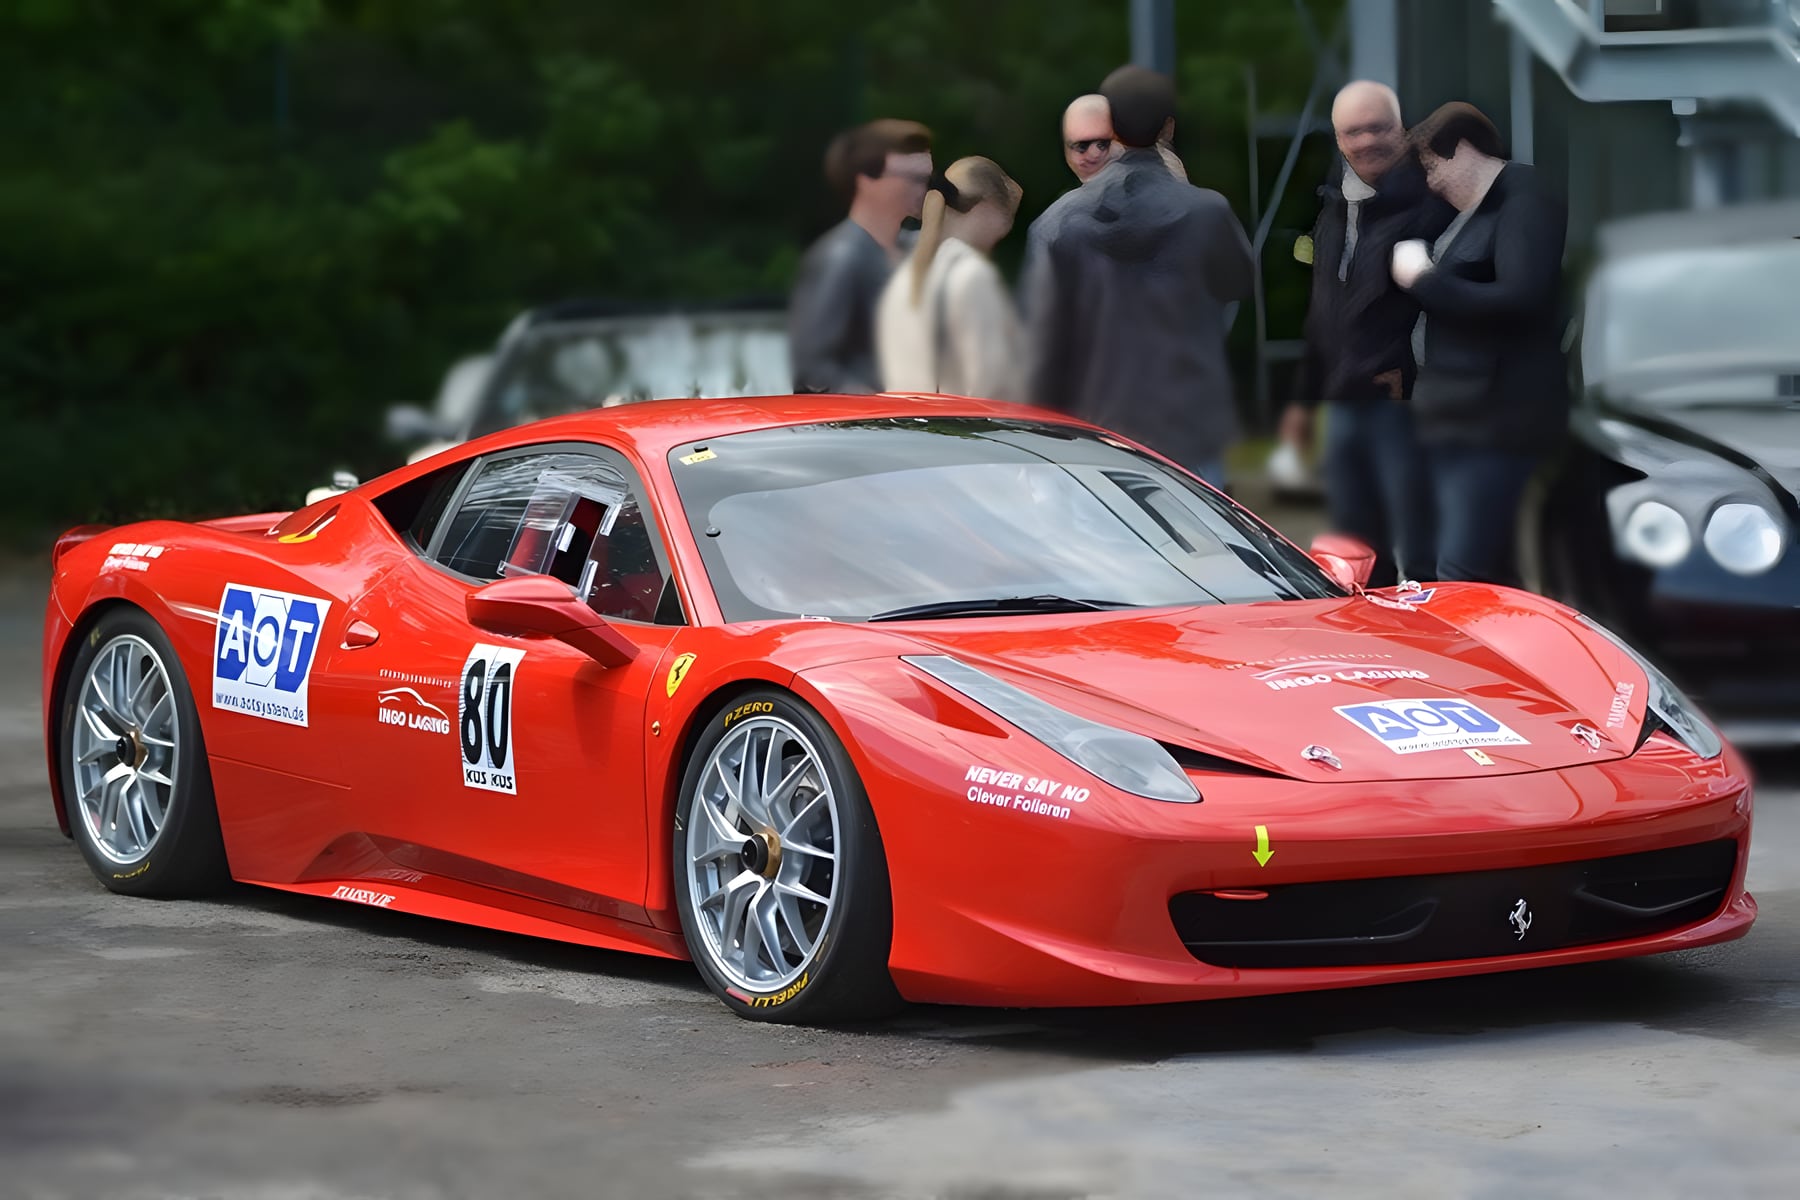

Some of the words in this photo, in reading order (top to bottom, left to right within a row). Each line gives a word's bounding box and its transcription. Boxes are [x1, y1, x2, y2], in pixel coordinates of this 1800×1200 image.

[220, 609, 315, 673] AOT
[378, 707, 407, 727] INGO
[461, 658, 511, 770] 80
[1367, 706, 1482, 734] AOT
[964, 765, 1024, 791] NEVER
[1024, 777, 1062, 797] SAY
[1061, 784, 1091, 803] NO
